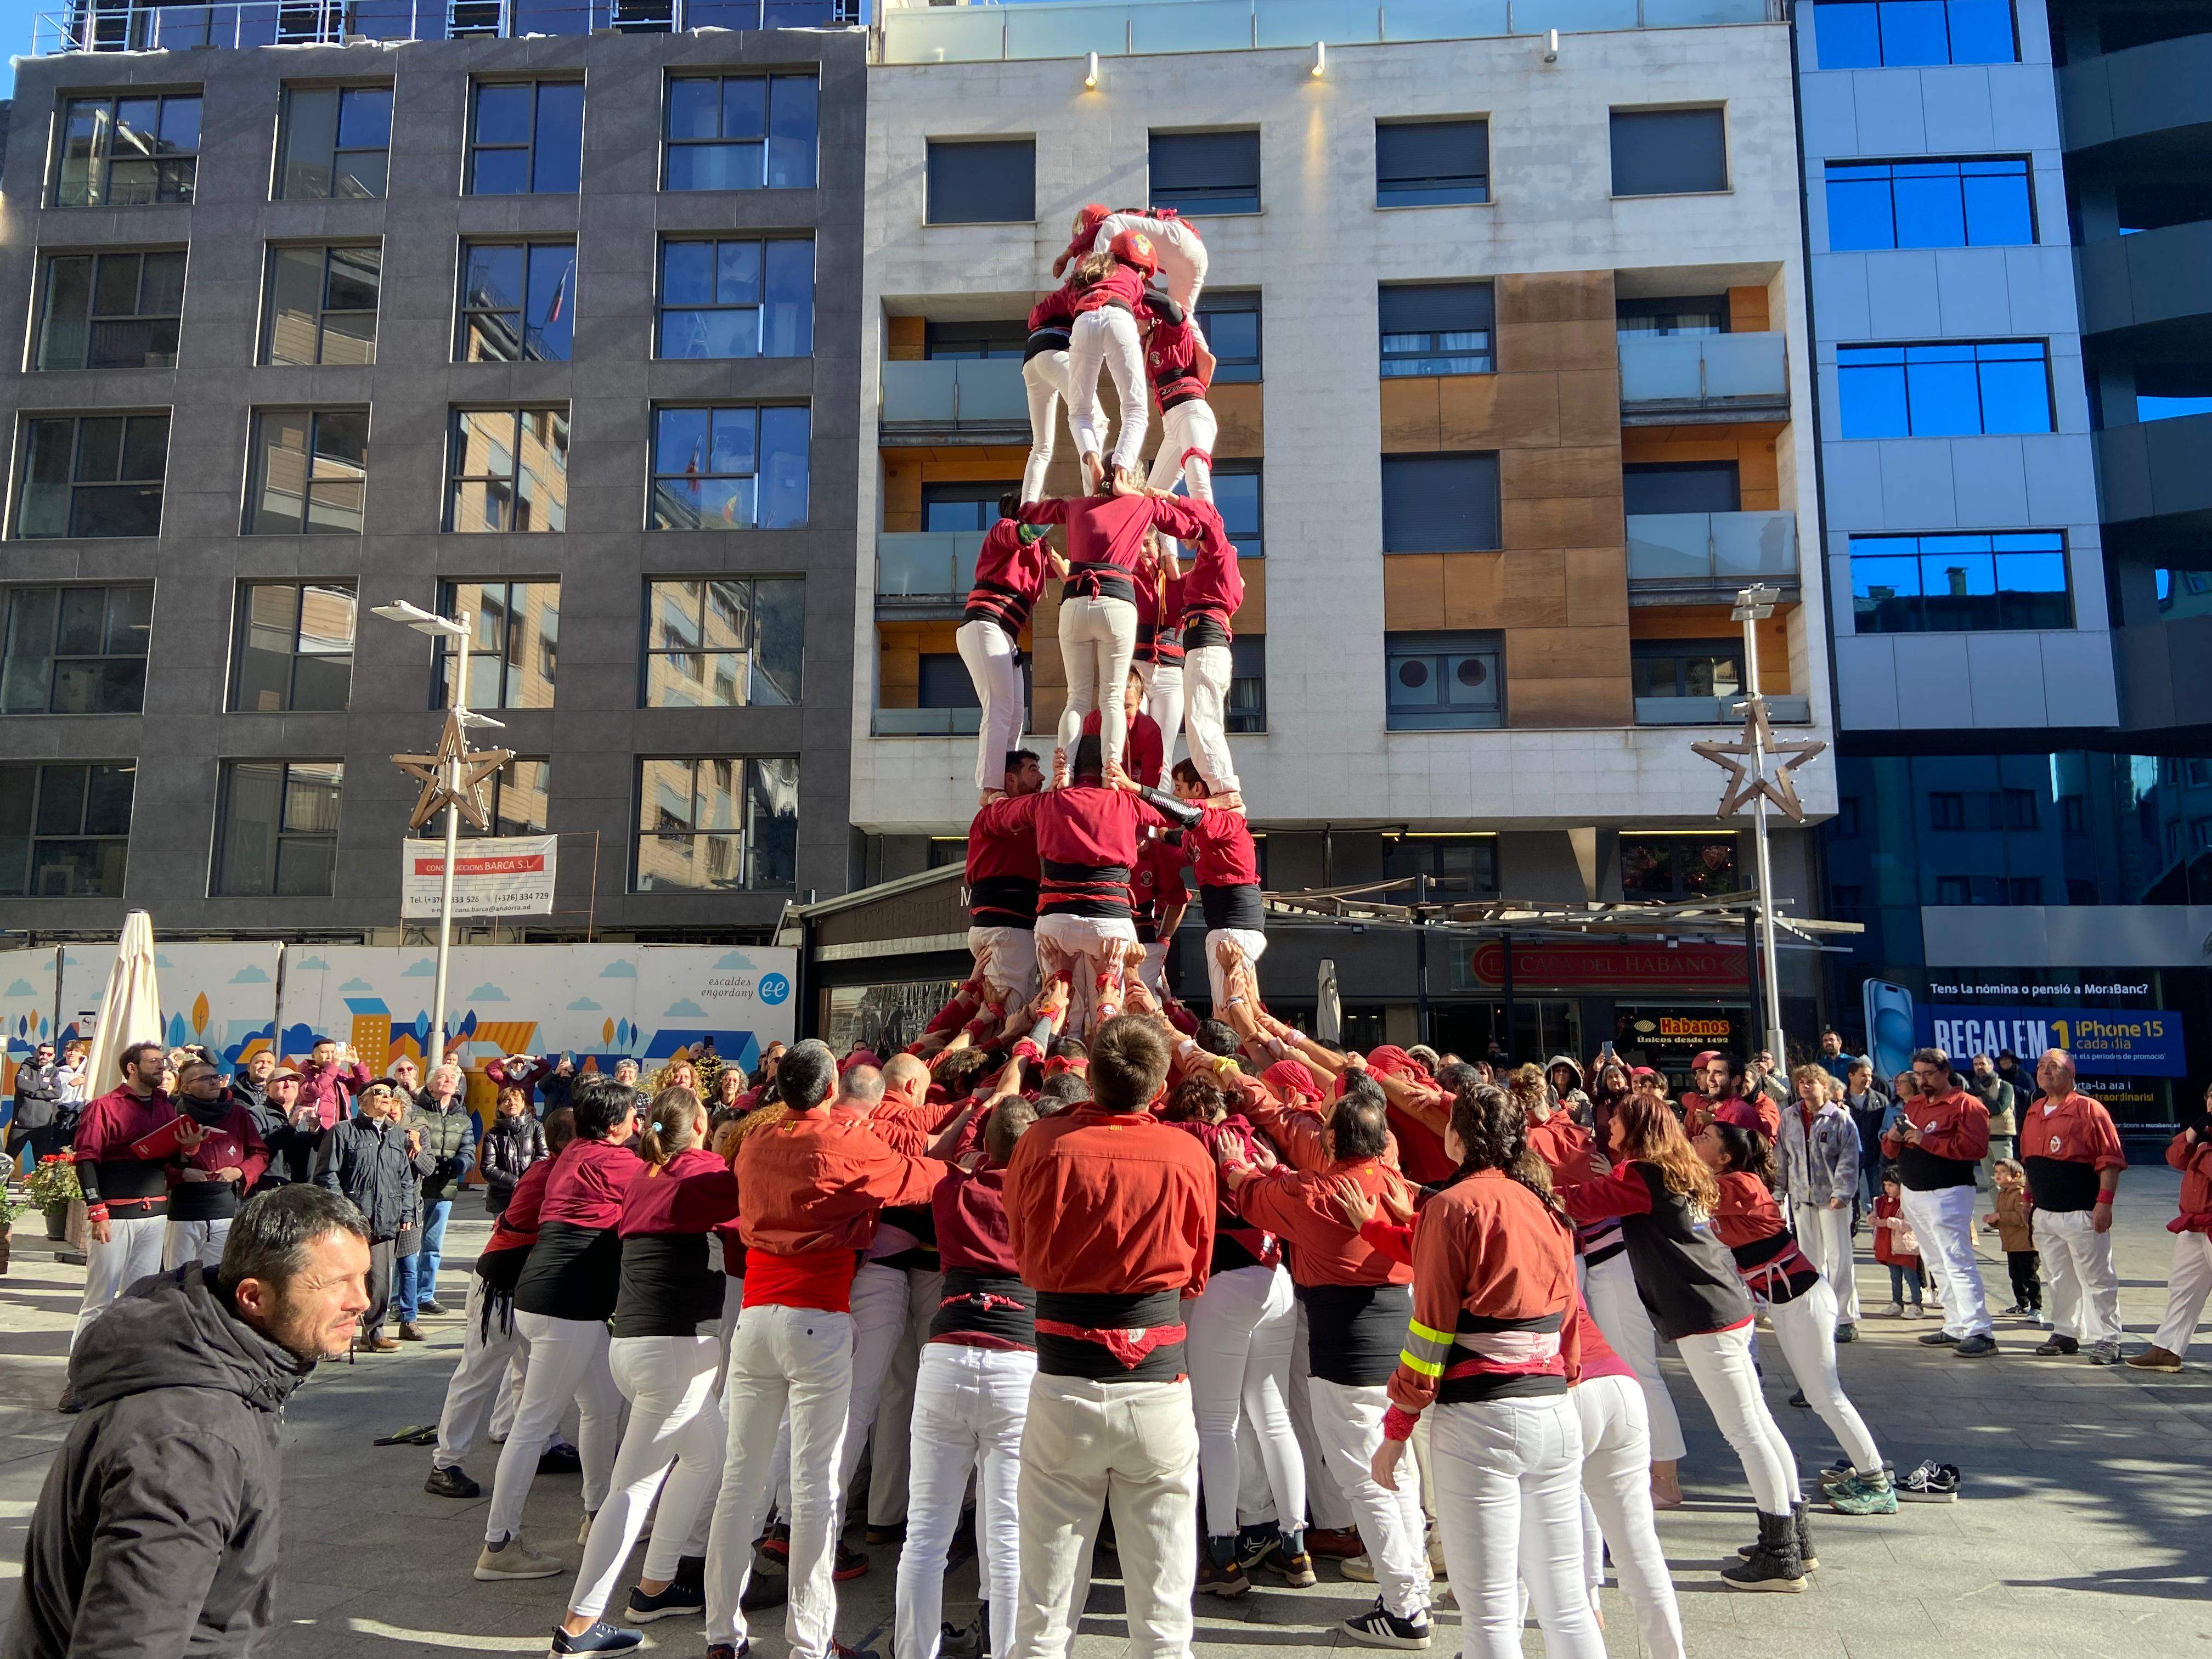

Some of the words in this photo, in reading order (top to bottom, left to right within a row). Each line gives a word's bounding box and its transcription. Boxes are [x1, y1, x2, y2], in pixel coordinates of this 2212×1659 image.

[484, 860, 515, 871] BARCA
[517, 860, 534, 869] S.L.
[425, 896, 443, 904] (+37
[495, 894, 518, 903] (+376)
[455, 904, 531, 913] cons.barca@andorra.ad
[1490, 958, 1504, 972] L
[1520, 956, 1572, 972] CASA
[1583, 958, 1617, 972] DEL
[1625, 956, 1716, 972] HABANO
[701, 988, 754, 1000] engordany
[1930, 984, 1958, 994] Tens
[1961, 983, 1973, 994] la
[1976, 984, 2018, 994] nòmina
[2021, 986, 2029, 994] o
[2032, 984, 2070, 997] pensió
[2074, 985, 2081, 994] a
[2084, 984, 2148, 994] MoraBanc?
[1660, 1017, 1730, 1035] Habanos
[1934, 1019, 2048, 1059] REGALEM
[2051, 1019, 2070, 1049] 1
[2075, 1020, 2141, 1037] iPhone
[2143, 1020, 2163, 1037] 15
[2076, 1038, 2108, 1049] cada
[2112, 1038, 2131, 1049] dia
